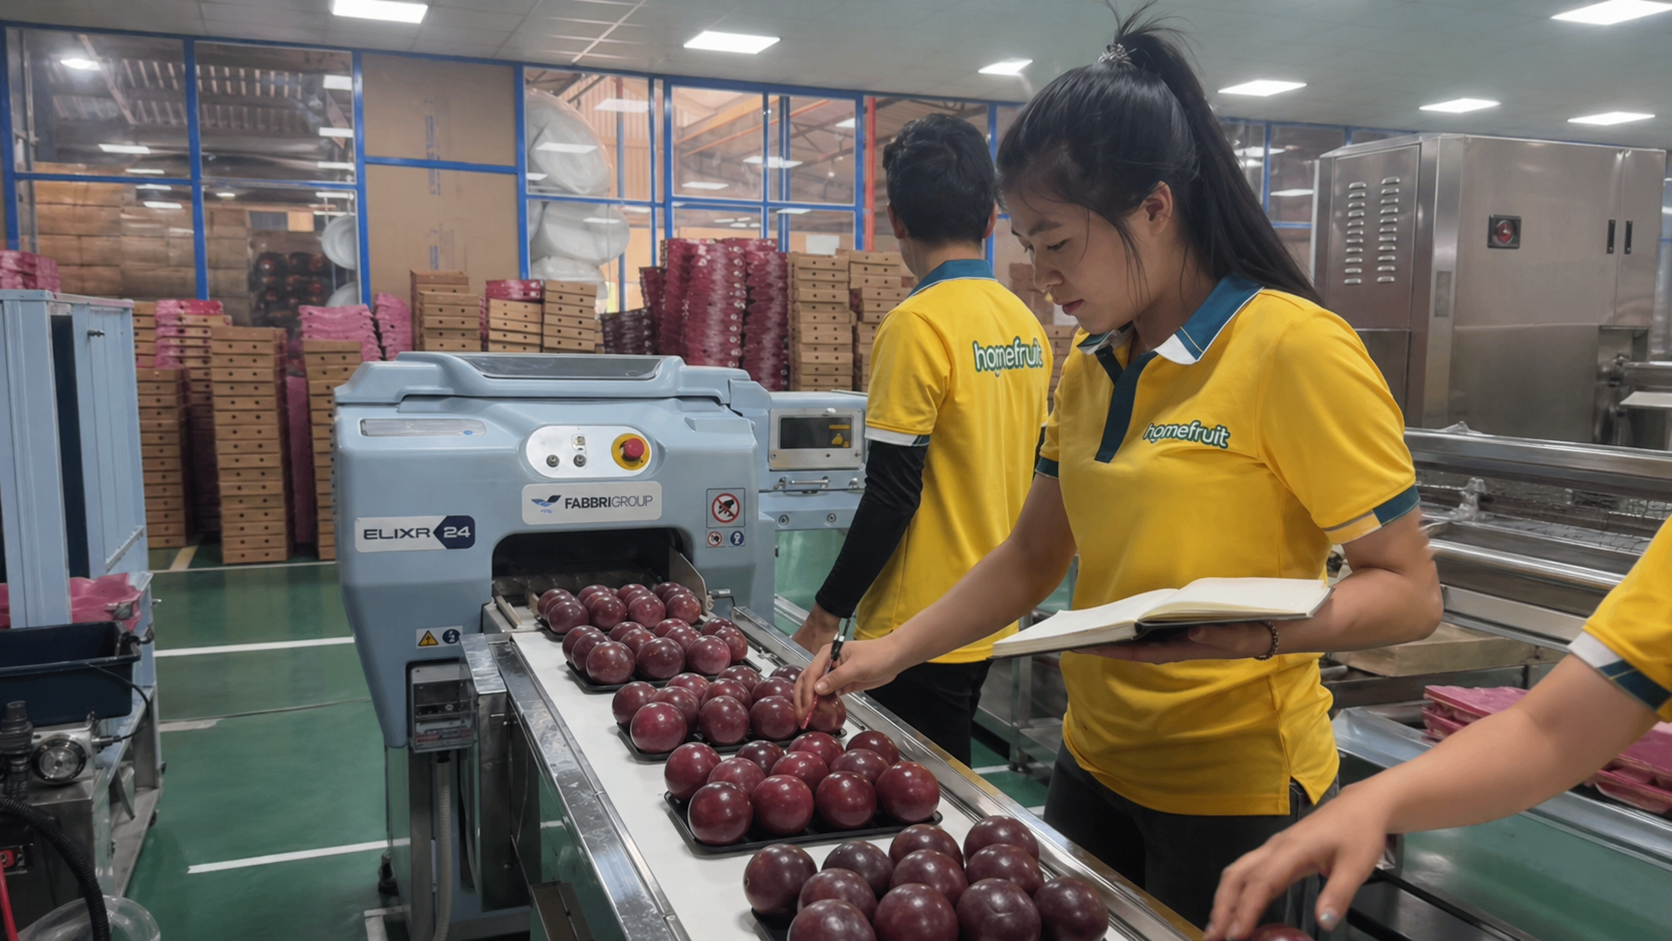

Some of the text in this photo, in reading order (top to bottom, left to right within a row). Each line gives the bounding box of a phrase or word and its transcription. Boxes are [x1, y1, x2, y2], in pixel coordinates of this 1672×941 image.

[973, 336, 1043, 373] homefruit
[1143, 420, 1230, 449] homefruit
[363, 526, 471, 540] ELIXR 24
